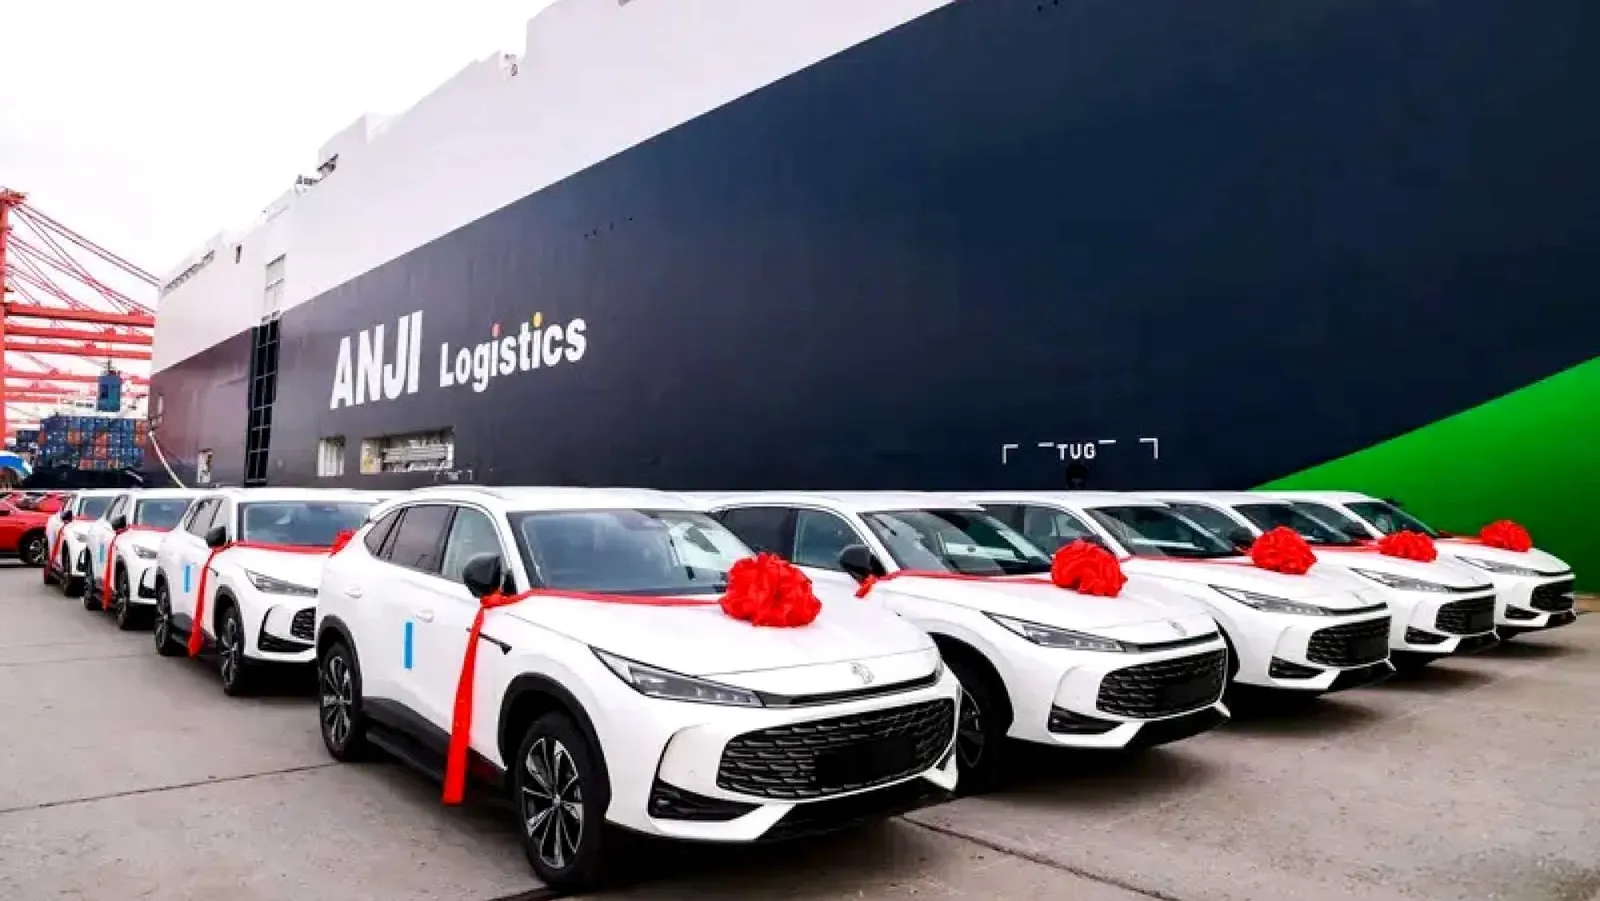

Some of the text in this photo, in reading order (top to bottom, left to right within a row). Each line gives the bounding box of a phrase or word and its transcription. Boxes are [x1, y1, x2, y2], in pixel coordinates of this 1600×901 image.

[330, 310, 587, 410] ANJI Logistics
[1057, 443, 1096, 460] TUG
